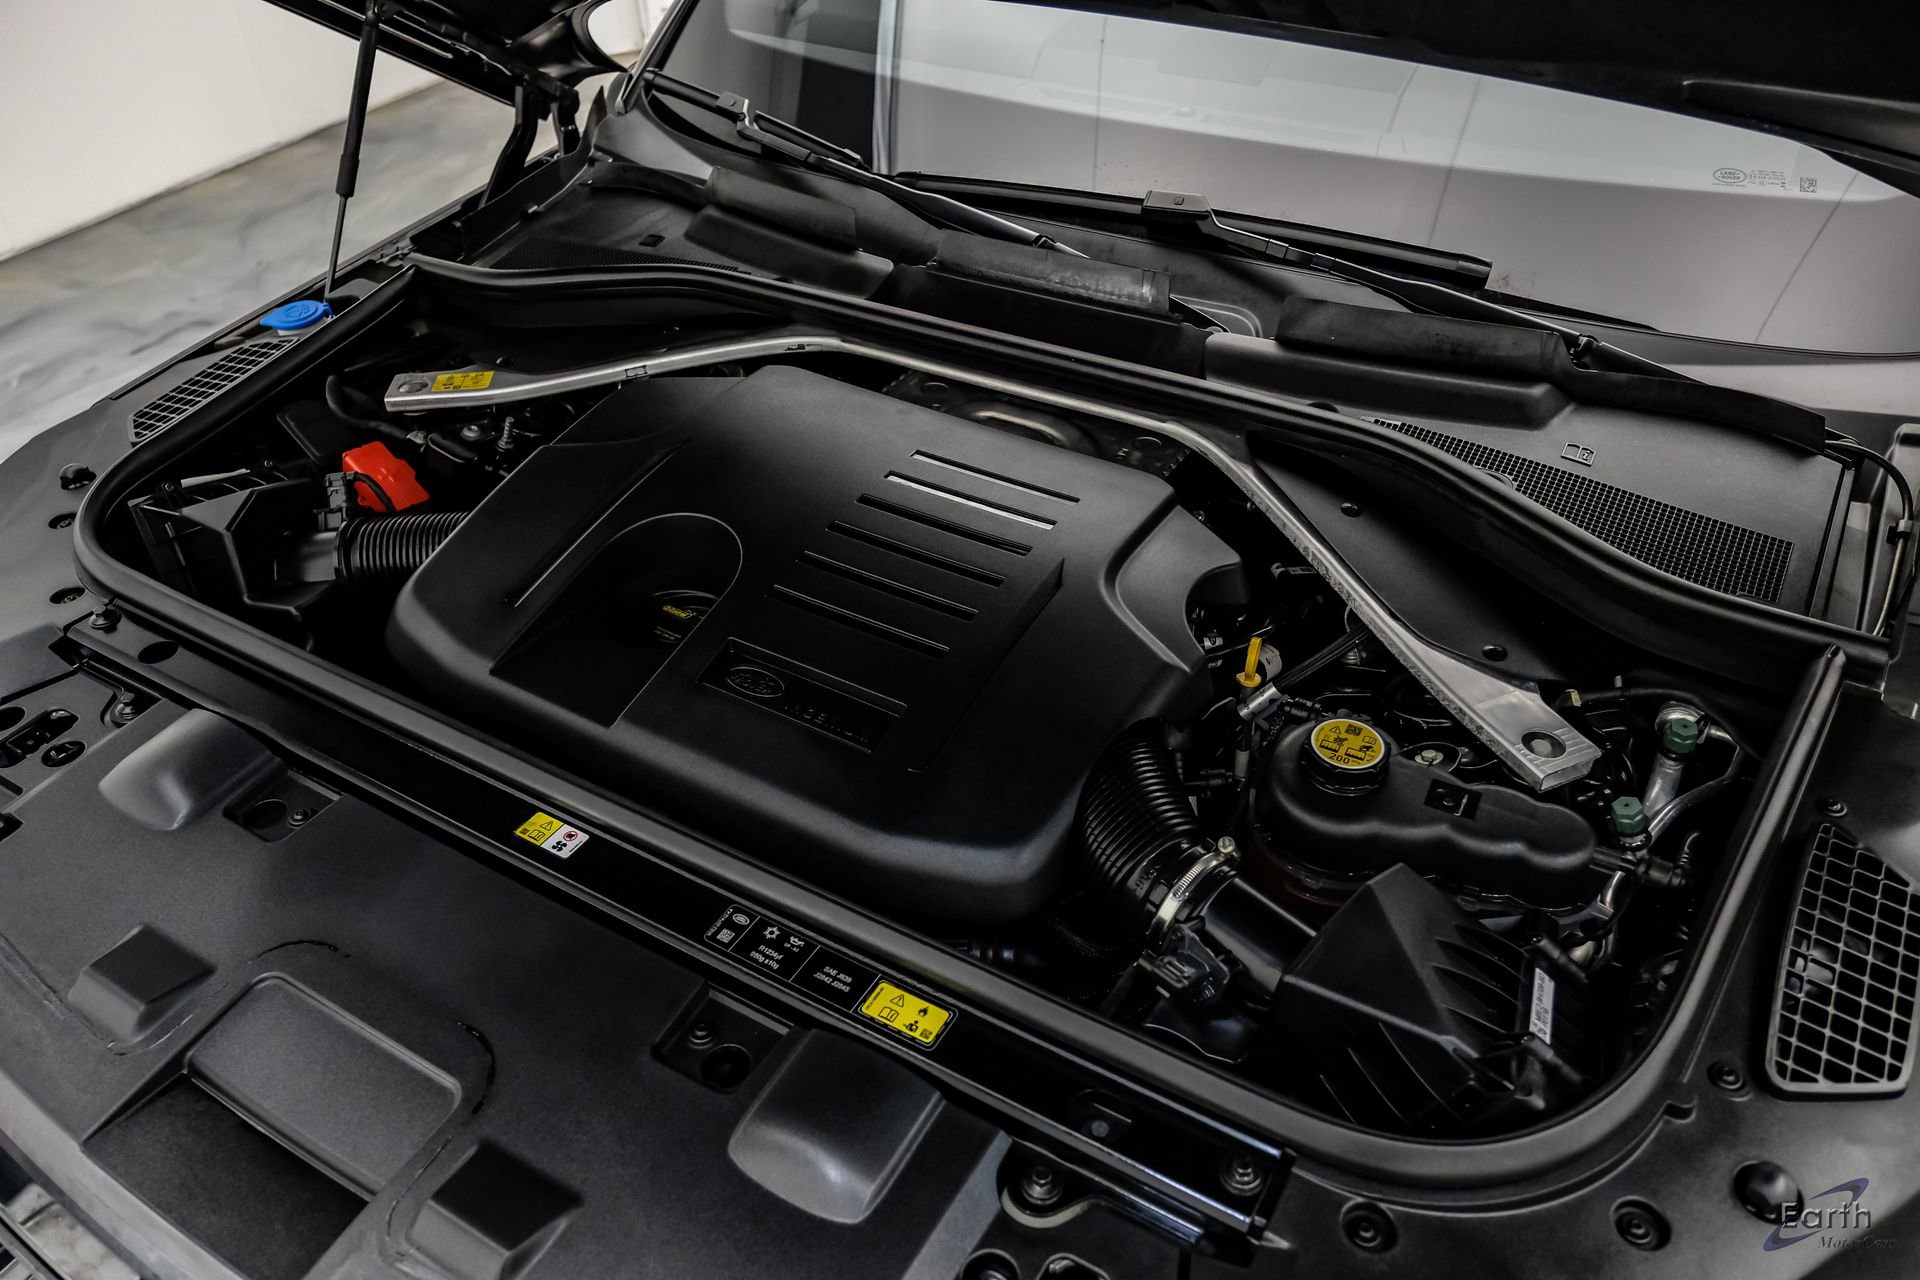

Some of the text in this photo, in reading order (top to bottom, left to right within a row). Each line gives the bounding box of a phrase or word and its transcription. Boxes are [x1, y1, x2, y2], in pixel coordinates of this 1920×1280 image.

[1328, 752, 1350, 765] 200
[758, 944, 784, 961] R1234yf
[824, 966, 838, 976] SAE
